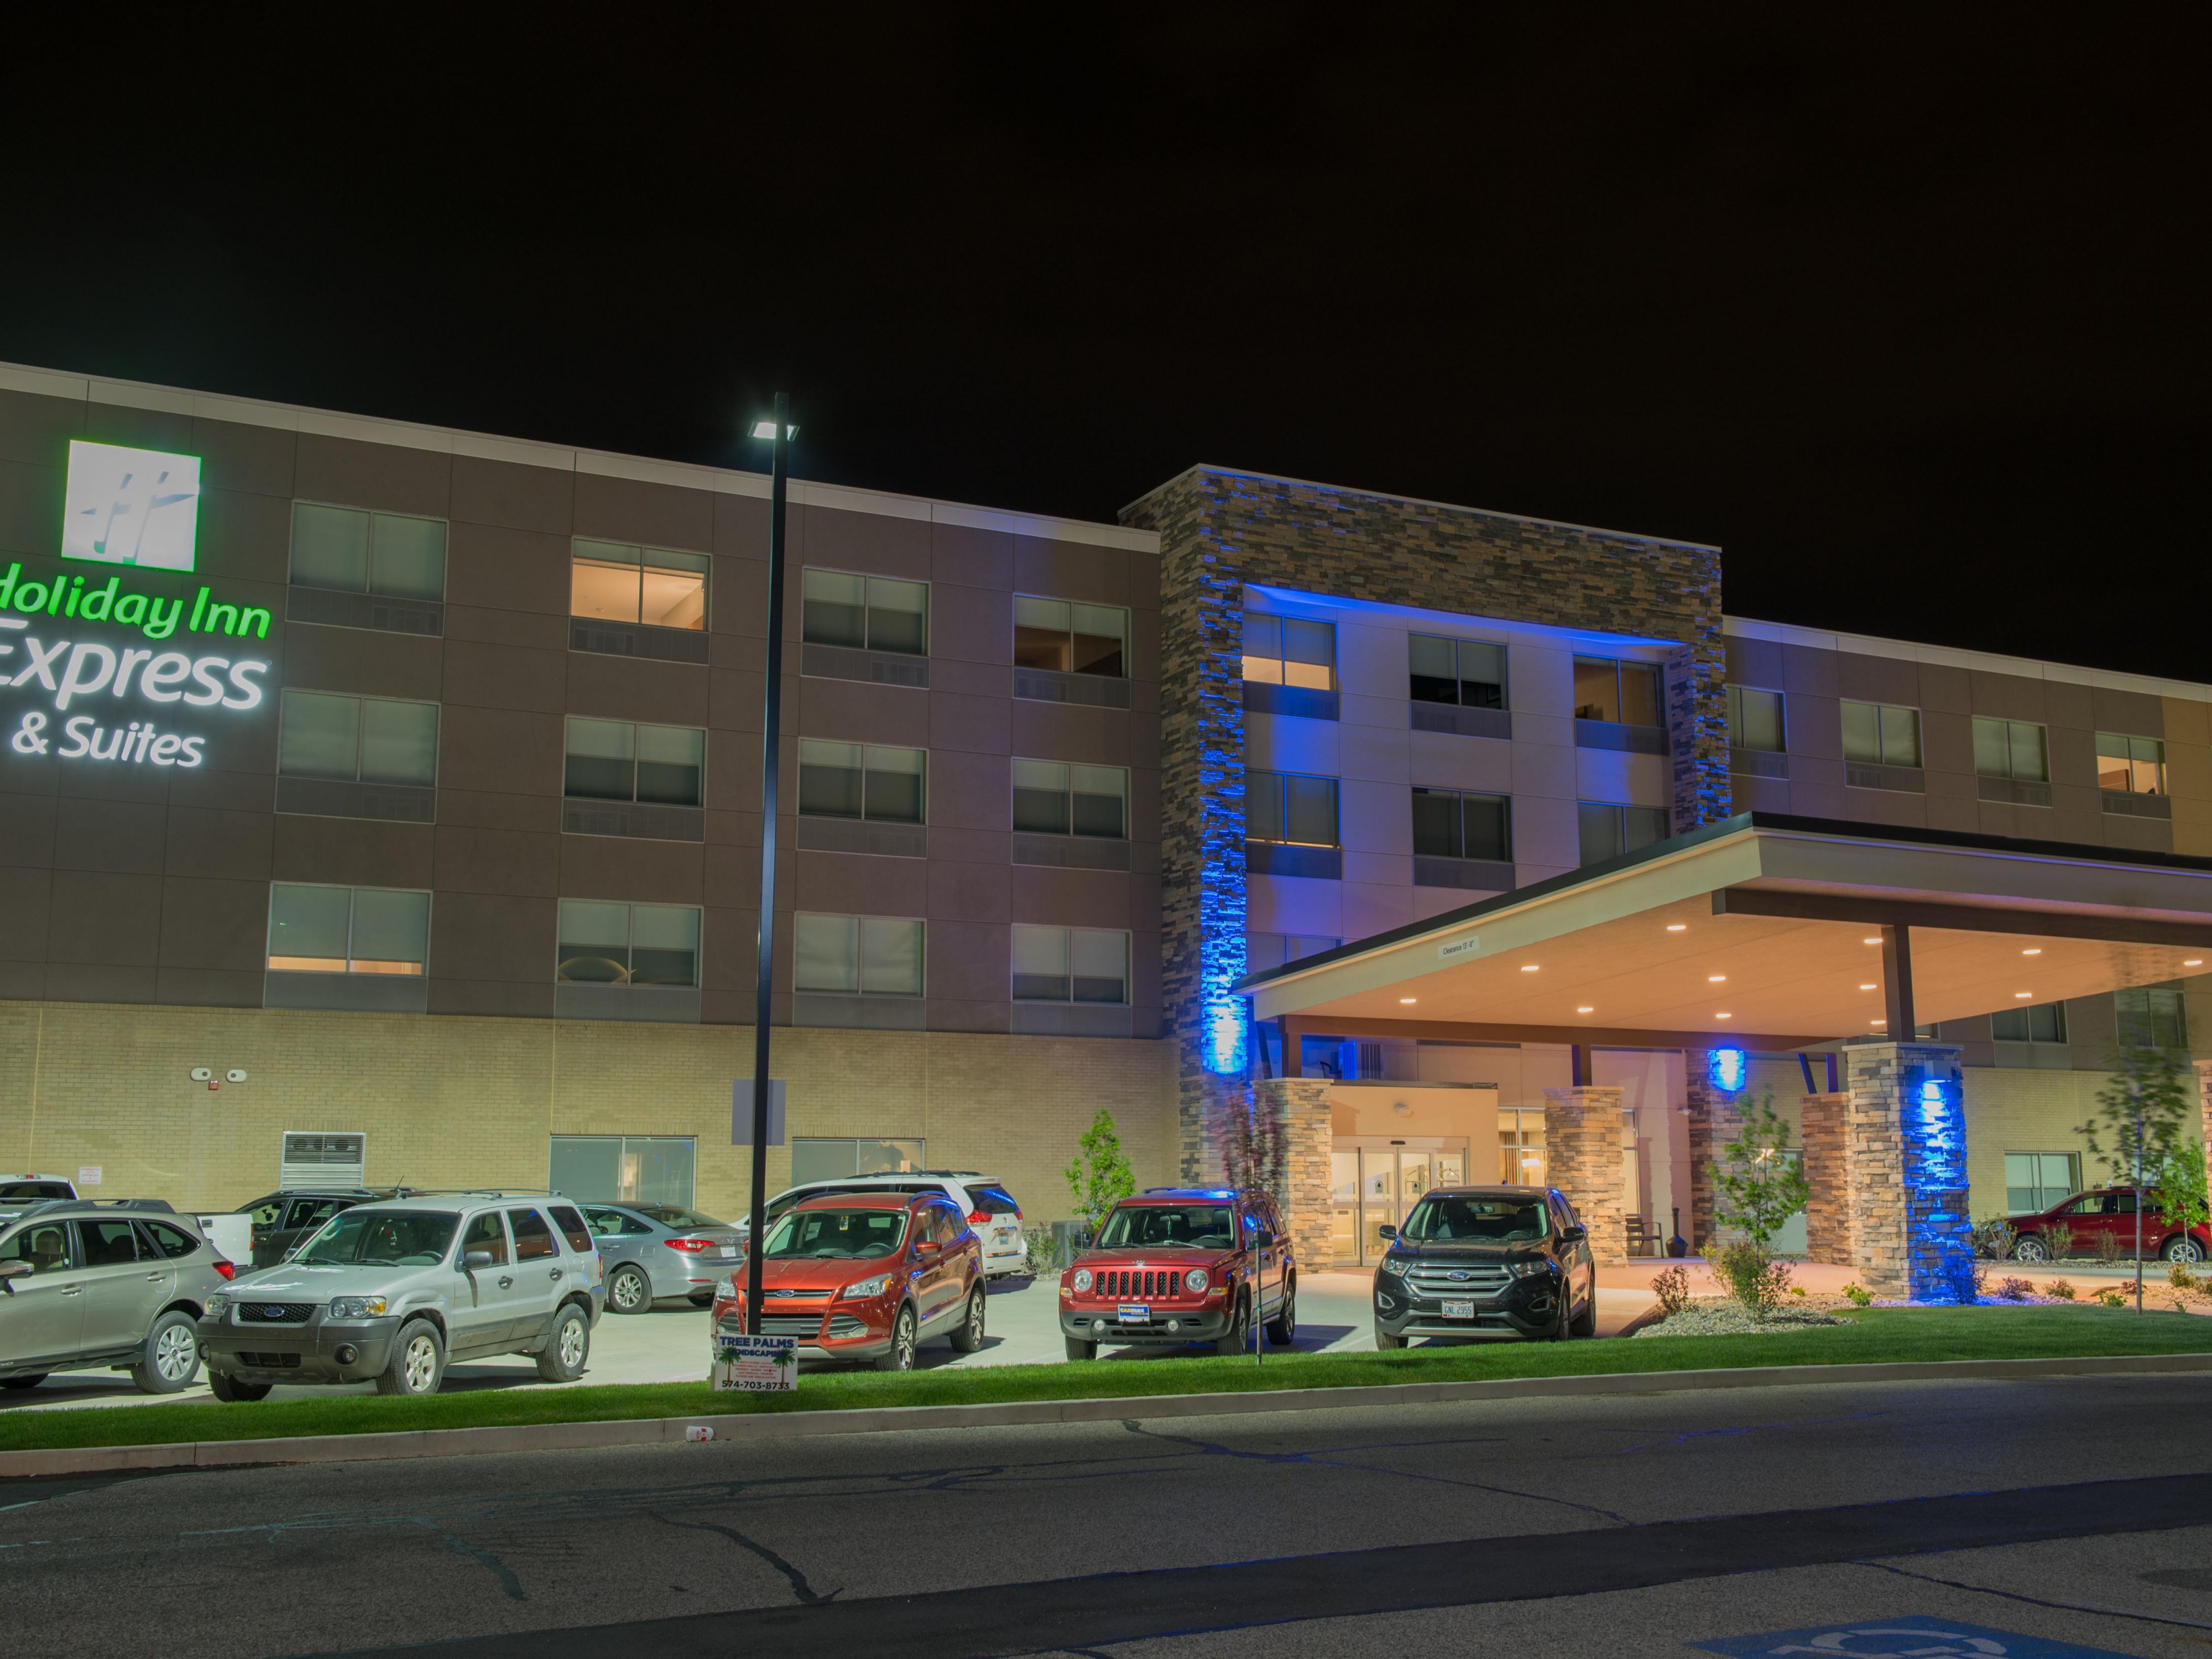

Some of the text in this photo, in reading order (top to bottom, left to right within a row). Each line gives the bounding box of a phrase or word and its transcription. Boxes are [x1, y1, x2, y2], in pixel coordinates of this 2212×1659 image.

[189, 586, 271, 640] Inn
[12, 712, 205, 767] & Suites
[1443, 943, 1462, 954] Clearance
[1444, 1306, 1472, 1314] GNL 2955
[719, 1336, 794, 1348] TREE PALMS
[722, 1380, 790, 1390] 574-703-8733
